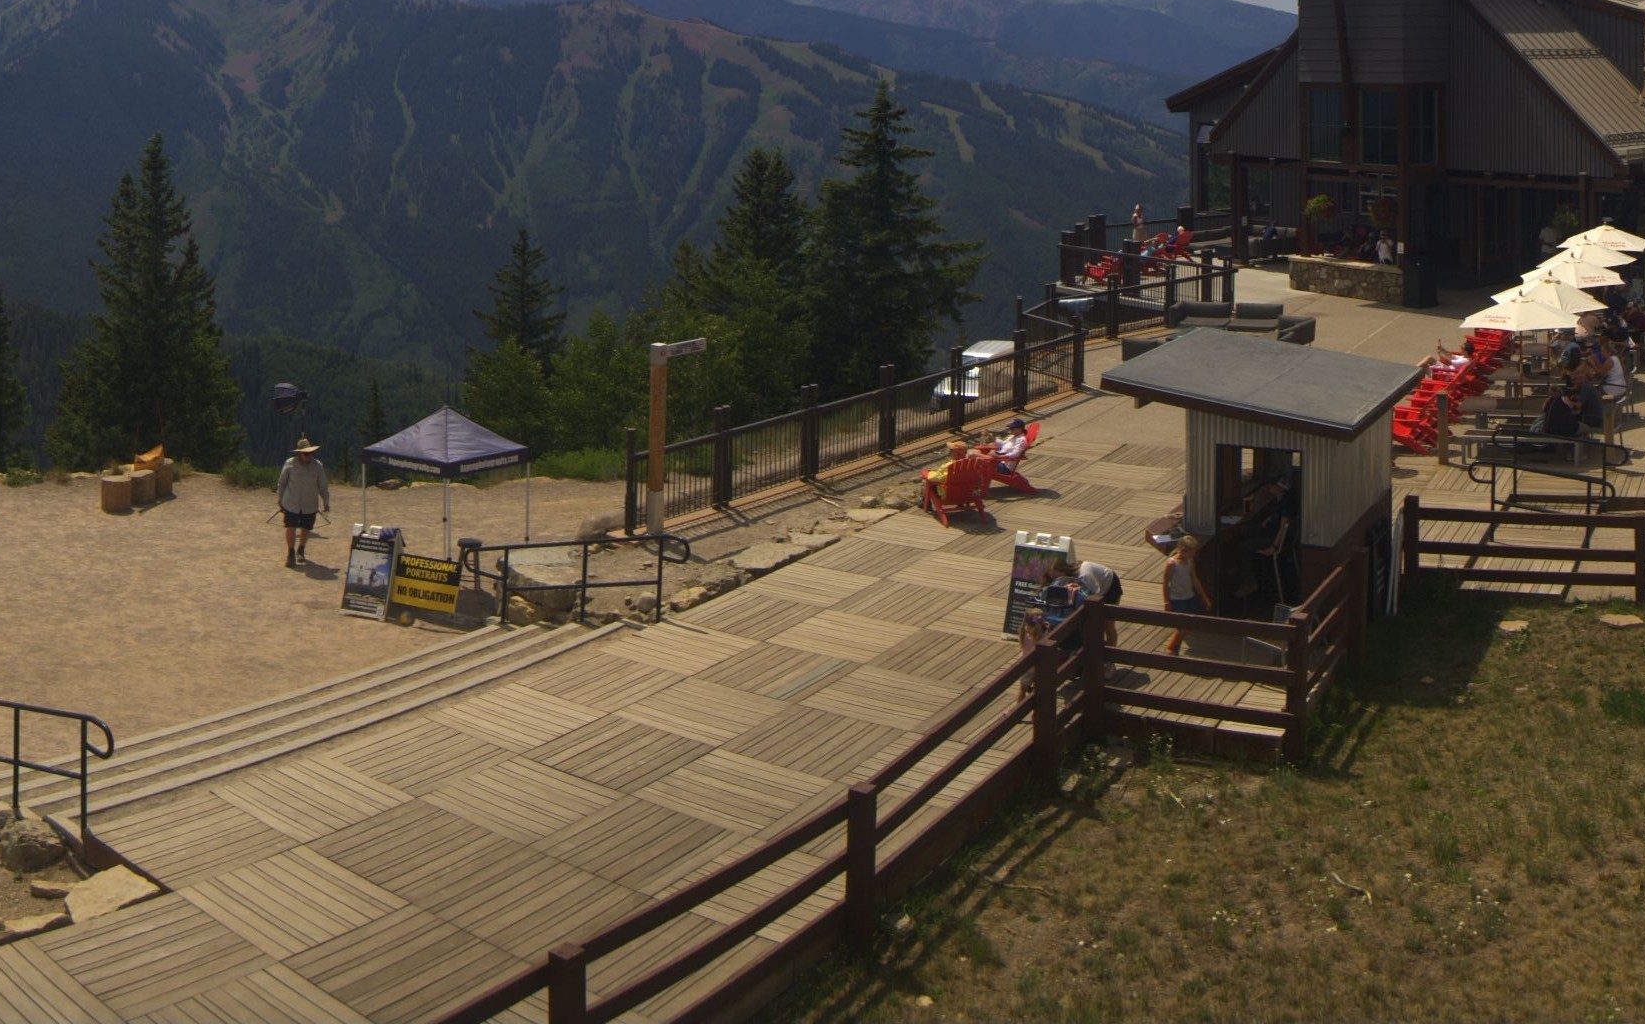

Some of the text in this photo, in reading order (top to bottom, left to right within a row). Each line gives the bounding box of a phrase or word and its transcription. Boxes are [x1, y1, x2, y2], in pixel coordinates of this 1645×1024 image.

[401, 555, 458, 573] PROFESSIONAL
[405, 568, 449, 582] PORTRAITS
[1015, 580, 1028, 588] FREE
[397, 584, 456, 604] NO OBLIGATION
